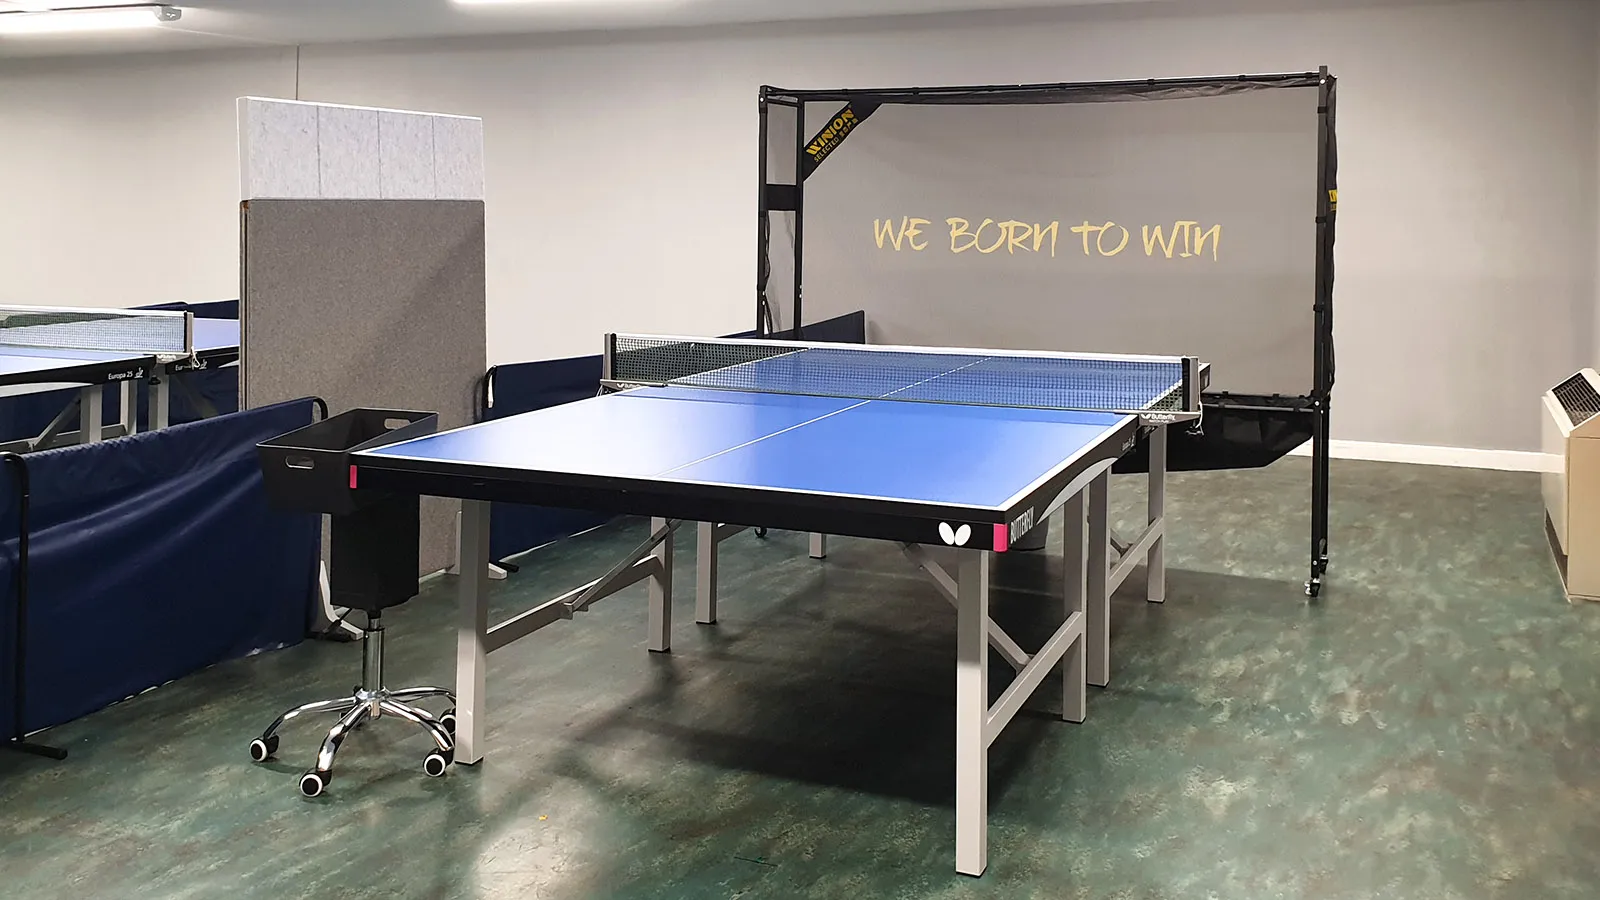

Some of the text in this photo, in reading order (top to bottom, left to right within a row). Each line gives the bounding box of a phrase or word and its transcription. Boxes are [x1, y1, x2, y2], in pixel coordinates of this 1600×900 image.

[806, 109, 854, 155] WINION
[813, 137, 840, 163] SELECTED
[873, 216, 1221, 261] WE BORN TO WIN
[108, 372, 126, 380] Europa
